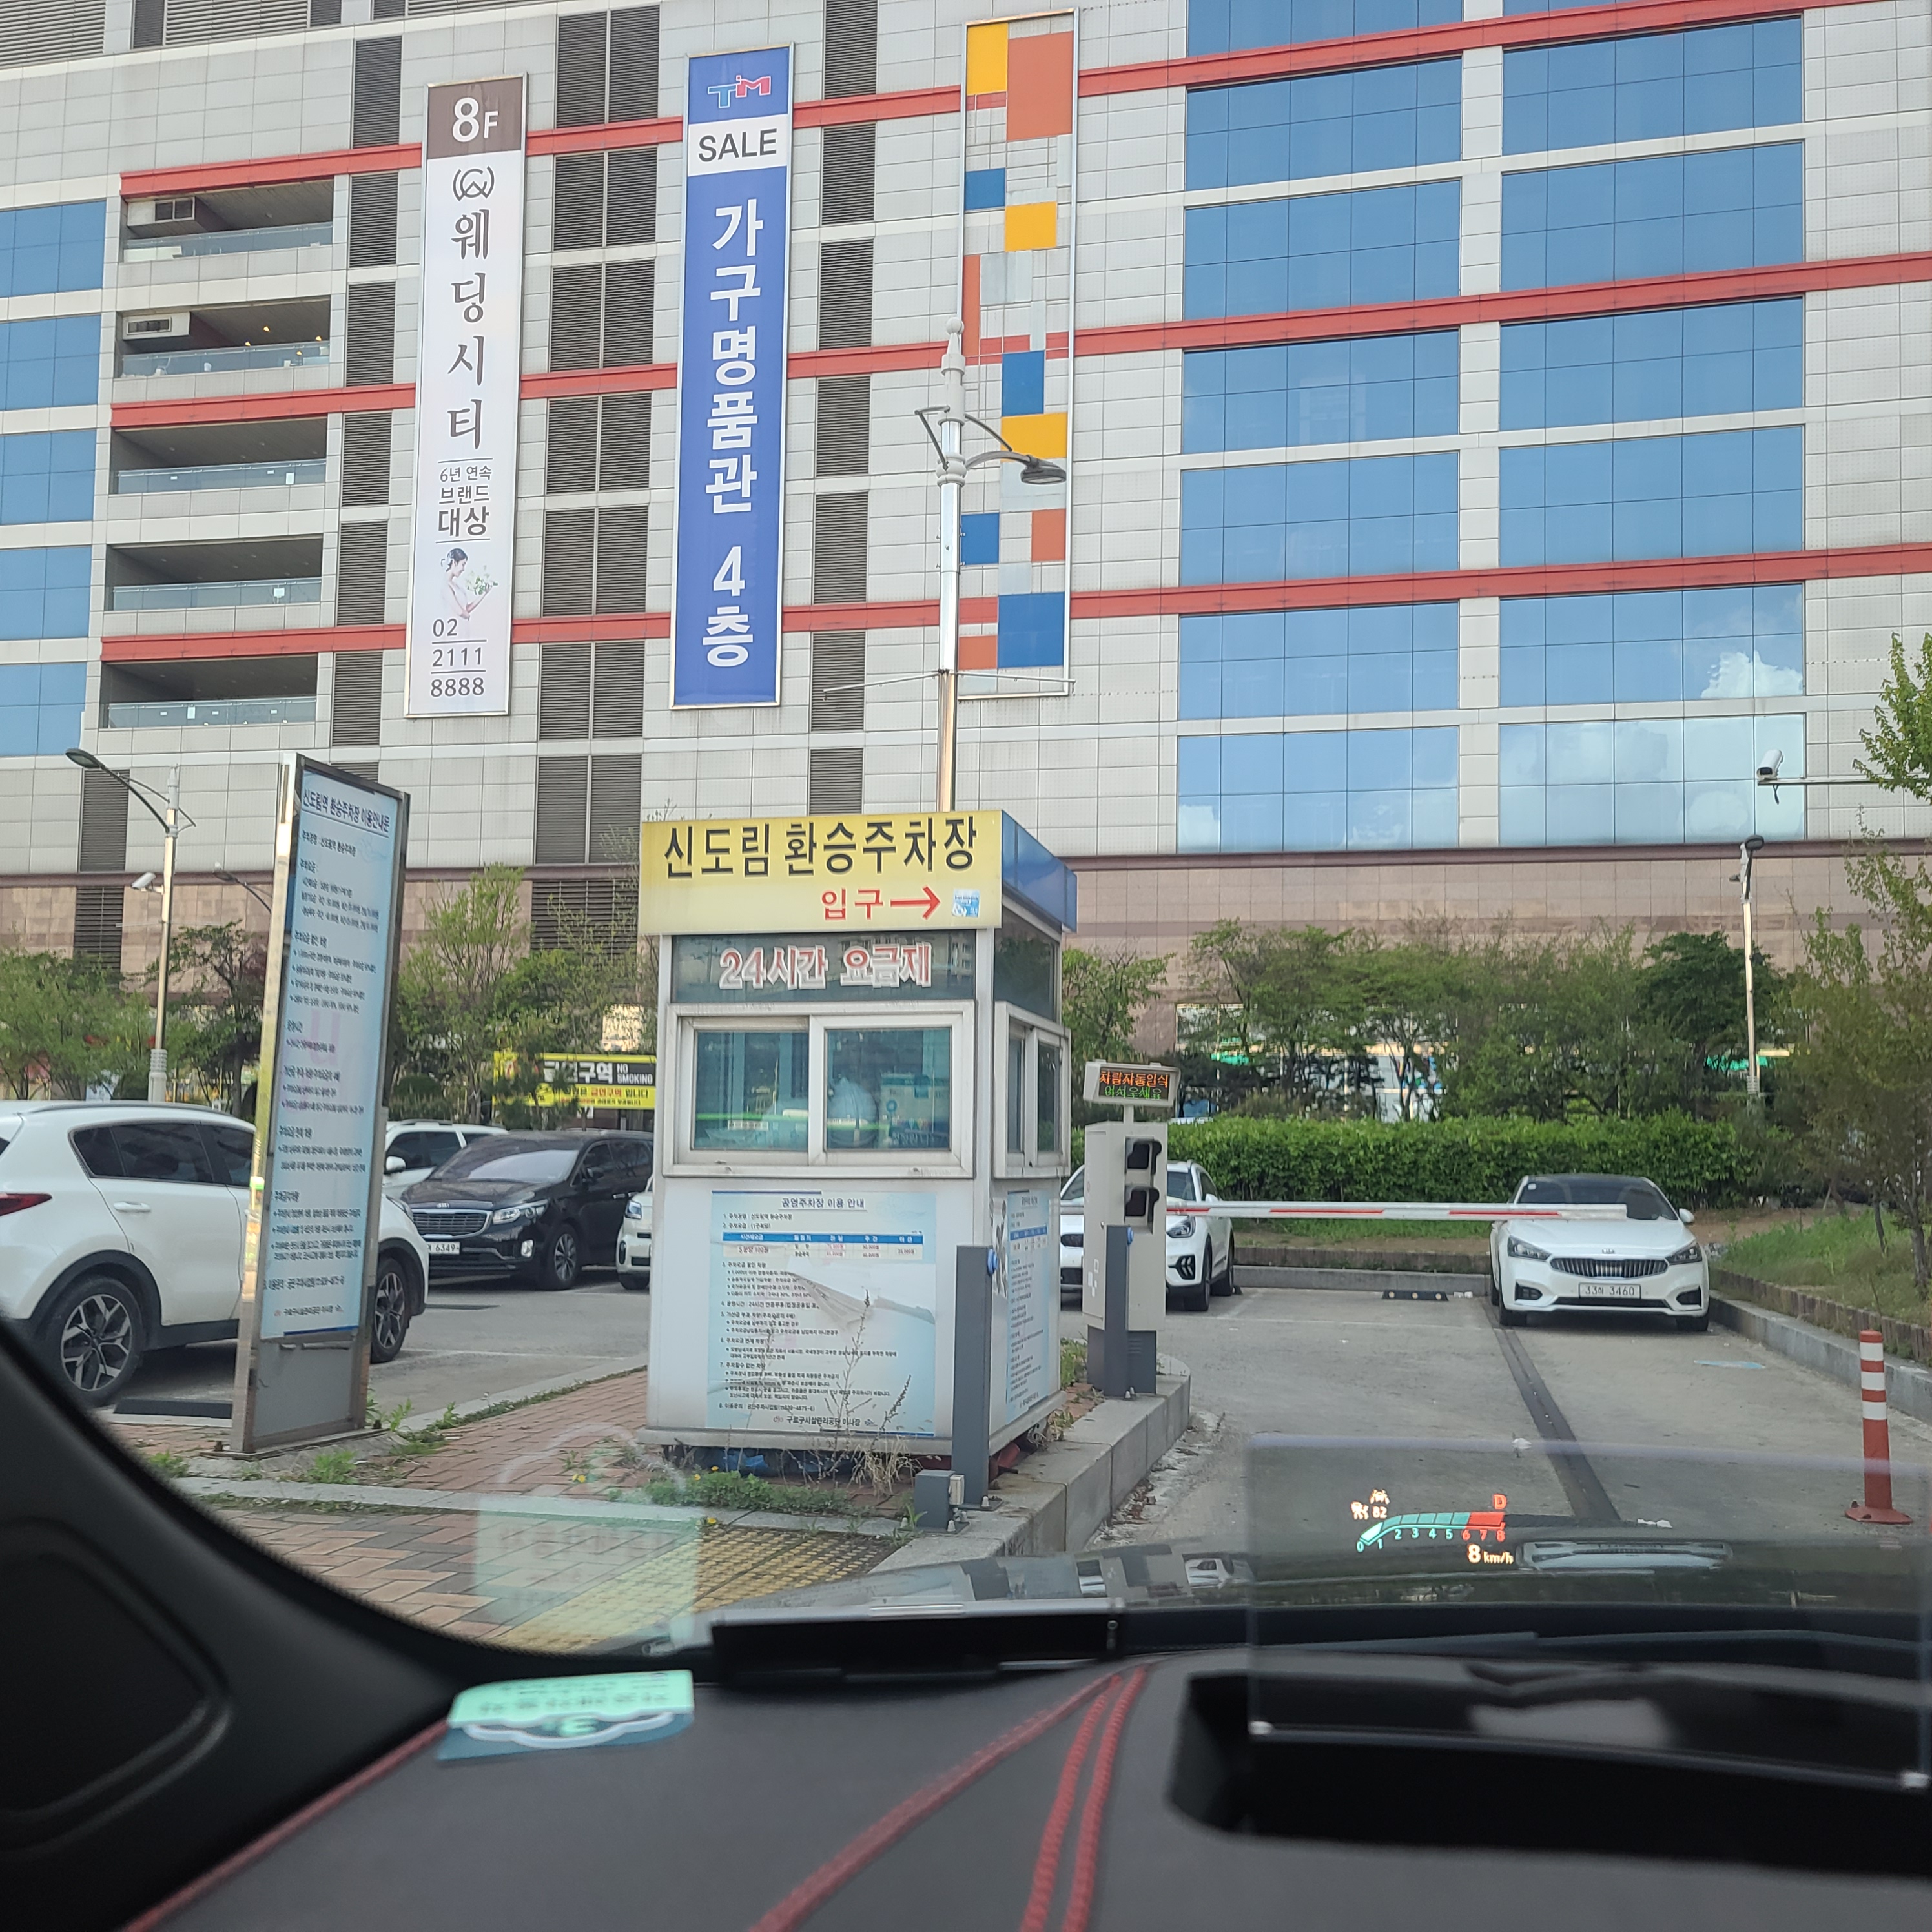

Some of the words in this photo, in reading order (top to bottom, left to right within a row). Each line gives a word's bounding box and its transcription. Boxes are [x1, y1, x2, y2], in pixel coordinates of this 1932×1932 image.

[698, 128, 777, 163] SALE
[447, 209, 490, 450] 웨딩시티
[706, 198, 763, 514] 가구명품관
[440, 468, 461, 483] 6년
[466, 465, 493, 482] 연속
[439, 484, 490, 505] 브랜드
[438, 506, 489, 538] 대상
[432, 618, 458, 637] 02
[431, 647, 482, 668] 2111
[430, 677, 485, 697] 8888
[303, 788, 328, 814] 신도림역
[330, 797, 360, 823] 환승주차장
[664, 821, 770, 879] 신도림
[784, 815, 979, 876] 환승주차장
[821, 887, 885, 921] 입구
[719, 945, 828, 990] 24시간
[617, 1064, 628, 1073] NO
[625, 1088, 648, 1098] 입니다
[782, 1198, 824, 1208] 공영주차장
[828, 1198, 844, 1208] 이용
[847, 1198, 865, 1209] 안내
[1609, 1286, 1634, 1295] 3460
[1493, 1494, 1506, 1510] D
[1468, 1544, 1481, 1563] 8
[1483, 1551, 1514, 1565] km/h
